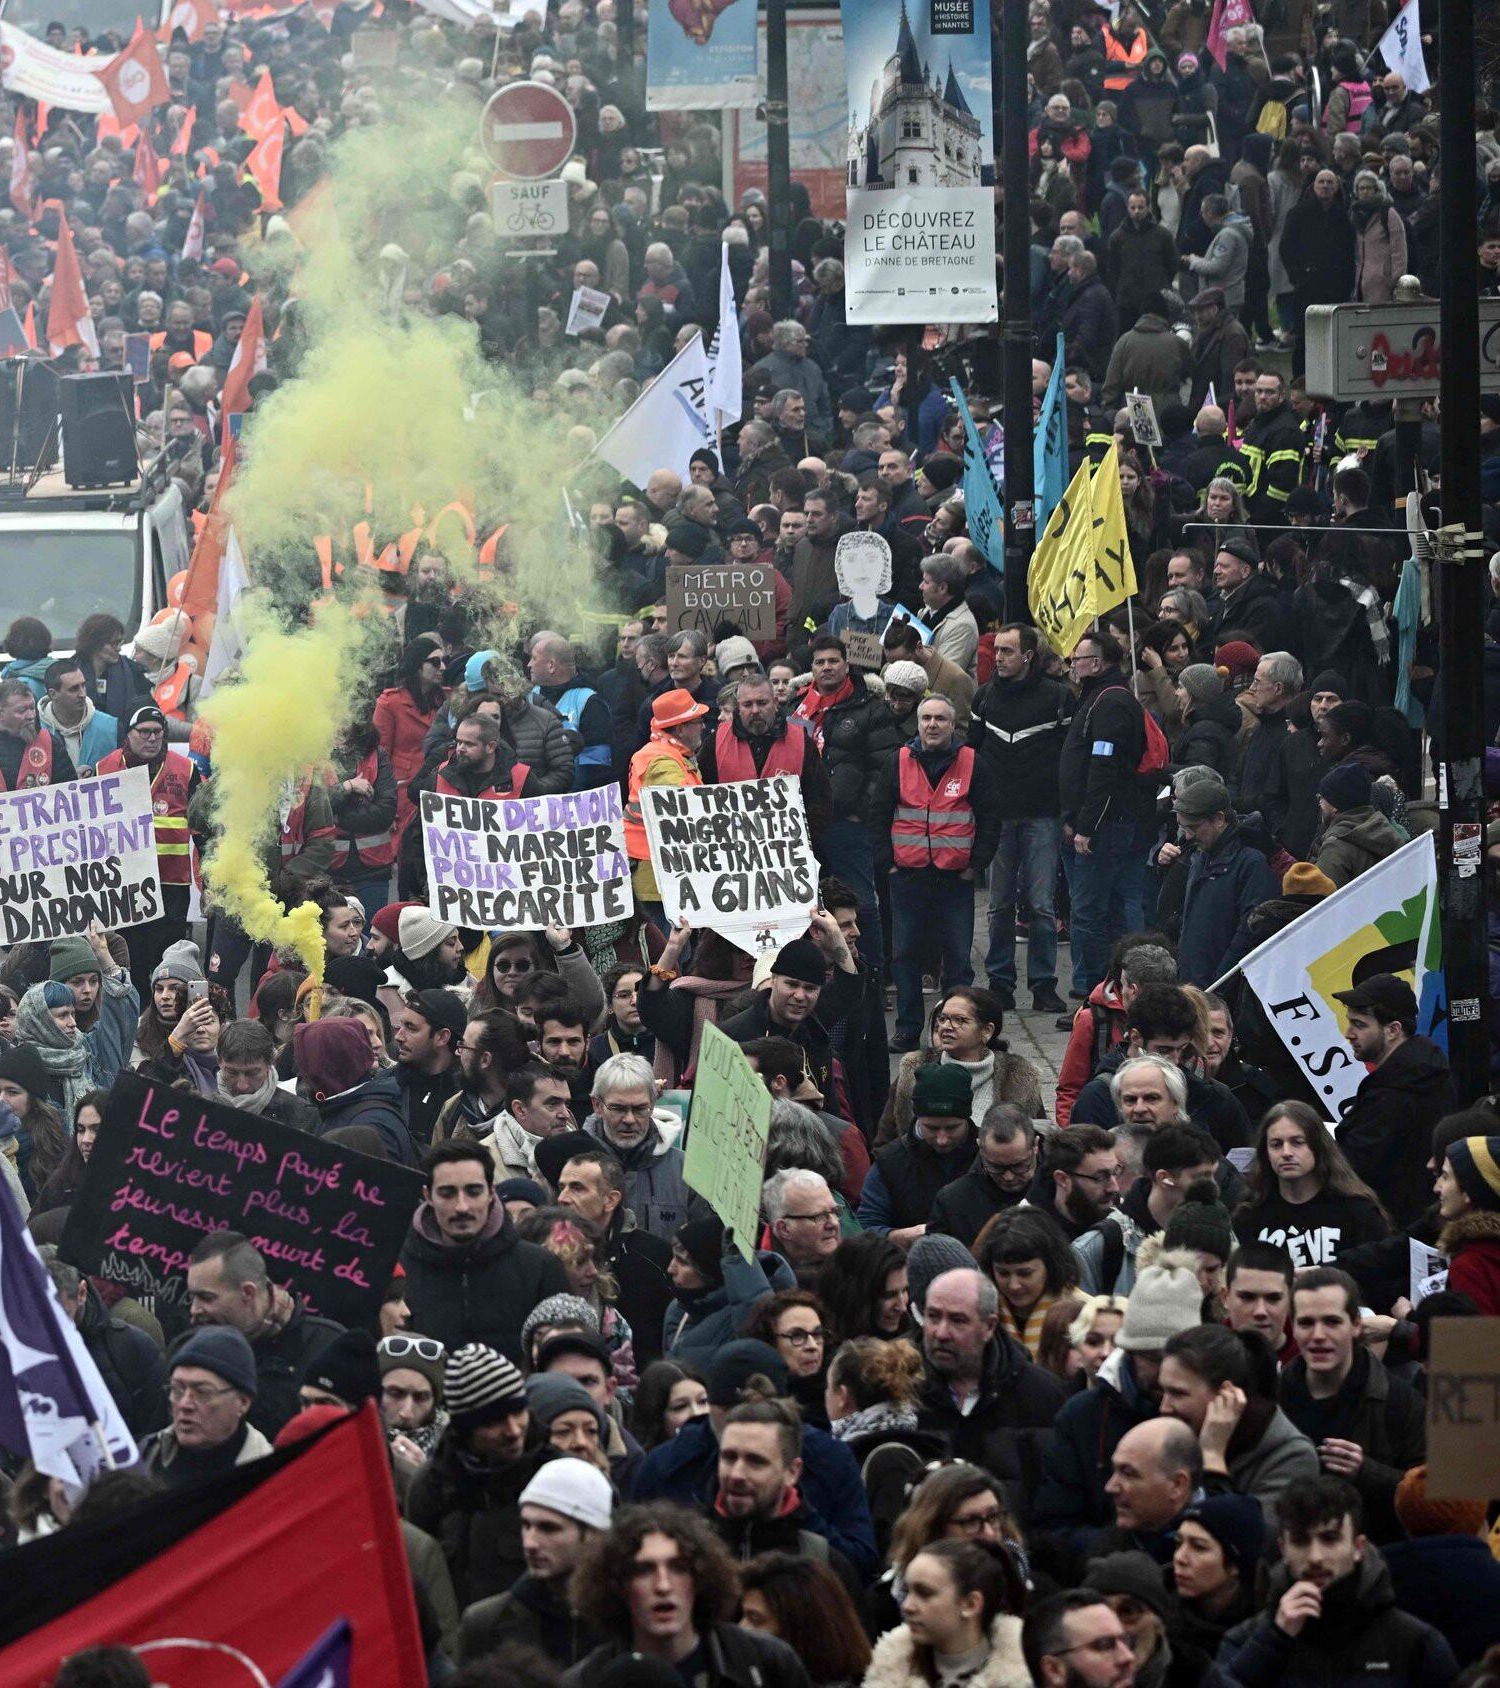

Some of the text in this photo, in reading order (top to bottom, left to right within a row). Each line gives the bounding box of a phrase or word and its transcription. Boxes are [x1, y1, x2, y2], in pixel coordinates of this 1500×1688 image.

[934, 0, 969, 12] MUSÉE
[942, 21, 970, 29] NANTES
[510, 185, 550, 200] SAUF
[863, 209, 975, 231] DÉCOUVREZ
[863, 230, 976, 252] LE CHÂTEAU
[865, 255, 975, 268] D'ANNE DE BRETAGNE
[684, 568, 764, 589] MÉTRO
[421, 783, 623, 833] PEUR DE DEVOIR
[741, 778, 789, 812] DES
[426, 824, 620, 864] ME MARIER
[64, 855, 123, 895] NOS
[432, 851, 630, 890] POUR FUIR LA
[711, 872, 749, 913] 67
[754, 865, 815, 911] ANS
[2, 876, 159, 944] DARONNES
[138, 1087, 386, 1206] Le temps payé ne
[124, 1144, 233, 1196] revient
[329, 1211, 375, 1248] la
[110, 1177, 231, 1234] jeunesse
[333, 1256, 371, 1288] de
